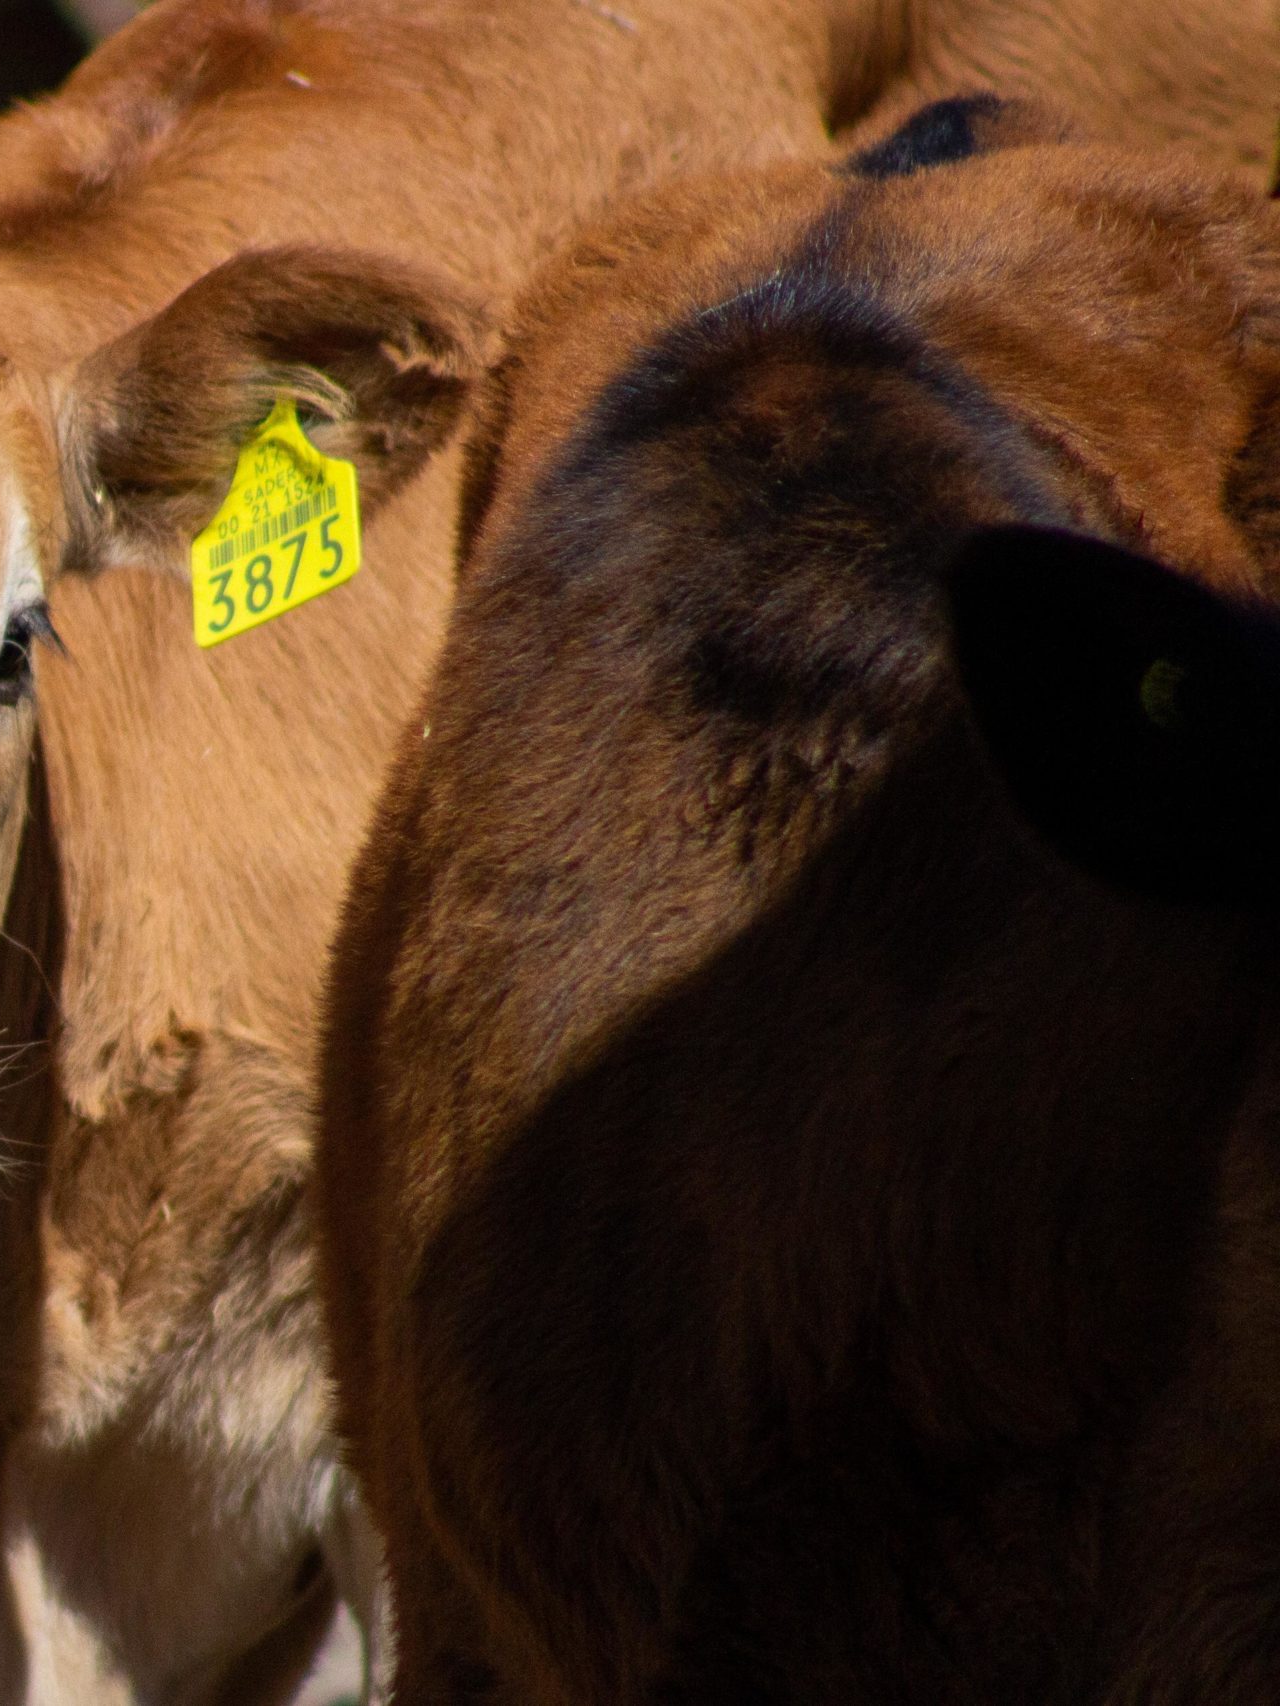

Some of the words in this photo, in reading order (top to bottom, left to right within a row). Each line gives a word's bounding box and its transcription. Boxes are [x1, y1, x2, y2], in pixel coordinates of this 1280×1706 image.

[244, 468, 297, 506] SADER
[218, 514, 240, 539] 00
[252, 500, 272, 523] 21
[208, 513, 343, 632] 3875
